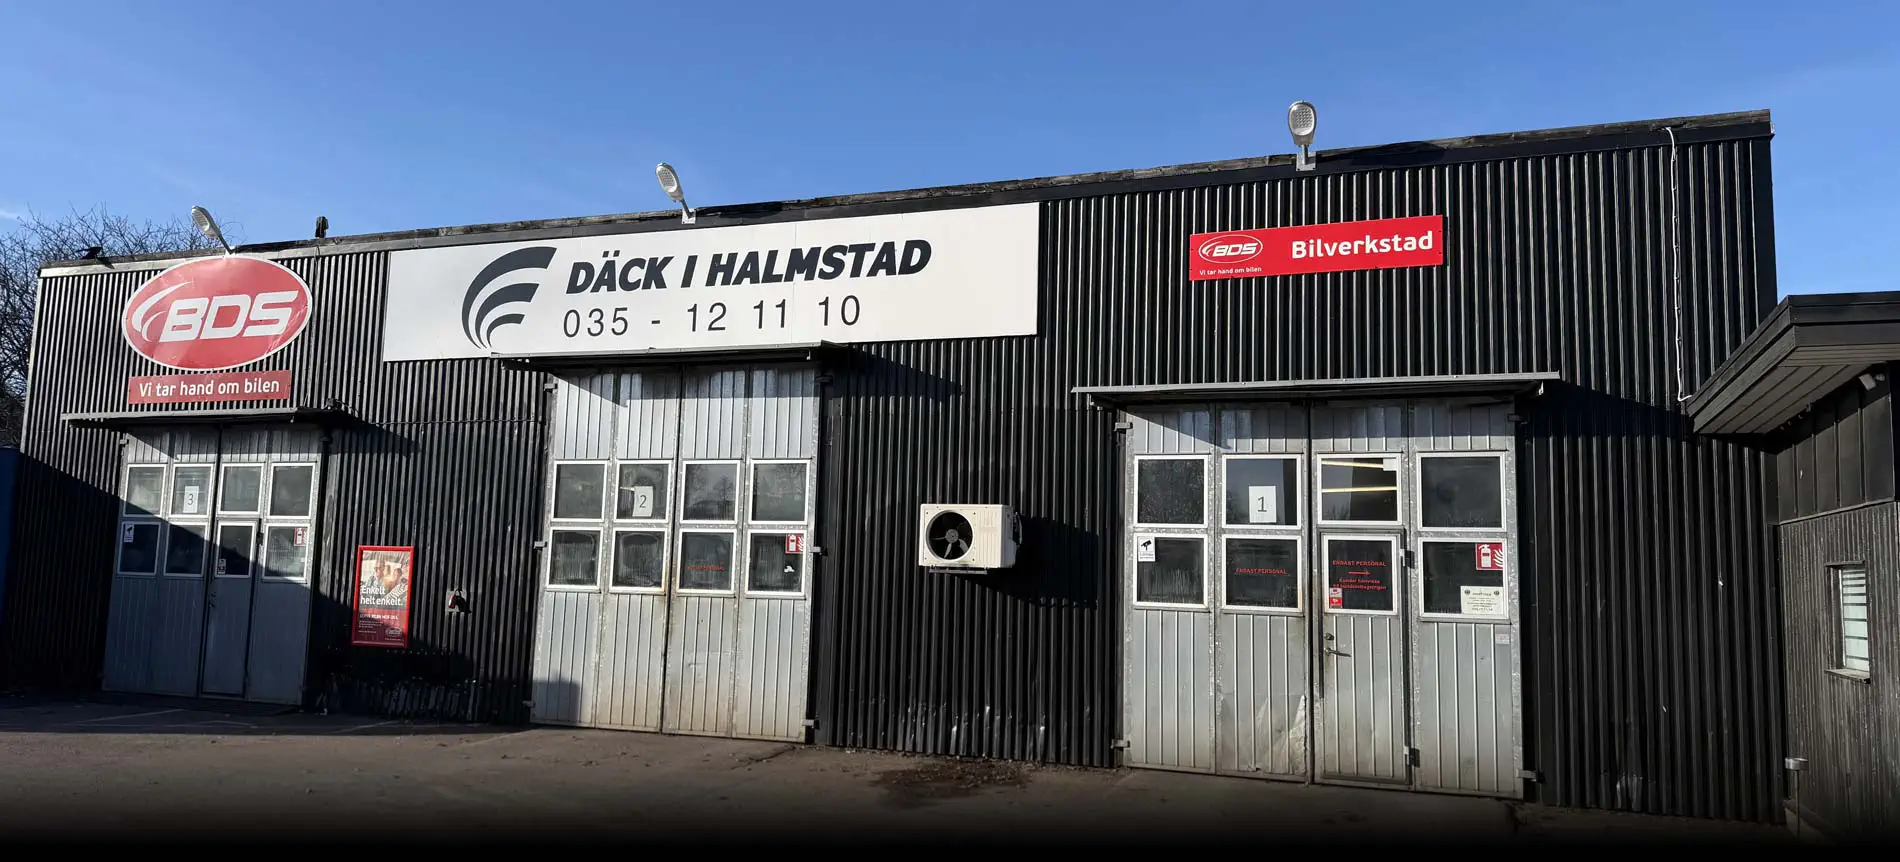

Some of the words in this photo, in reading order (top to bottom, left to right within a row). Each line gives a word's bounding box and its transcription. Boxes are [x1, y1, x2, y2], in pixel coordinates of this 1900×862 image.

[1212, 242, 1258, 256] BDS
[1291, 230, 1433, 259] Bilverkstad
[565, 250, 675, 294] DÄCK
[680, 254, 698, 288] I
[705, 239, 932, 287] HALMSTAD
[1217, 267, 1234, 275] hand
[159, 290, 299, 343] BDS
[563, 306, 629, 338] 035
[687, 301, 727, 333] 12
[753, 297, 787, 330] 11
[818, 294, 861, 327] 10
[139, 382, 152, 398] Vi
[156, 383, 176, 397] tar
[180, 379, 214, 396] hand
[218, 383, 240, 395] om
[244, 377, 280, 393] bilen
[187, 493, 194, 506] 3
[639, 494, 647, 509] 2
[1257, 496, 1268, 513] 1
[360, 585, 386, 595] Enkelt
[359, 596, 376, 605] helt
